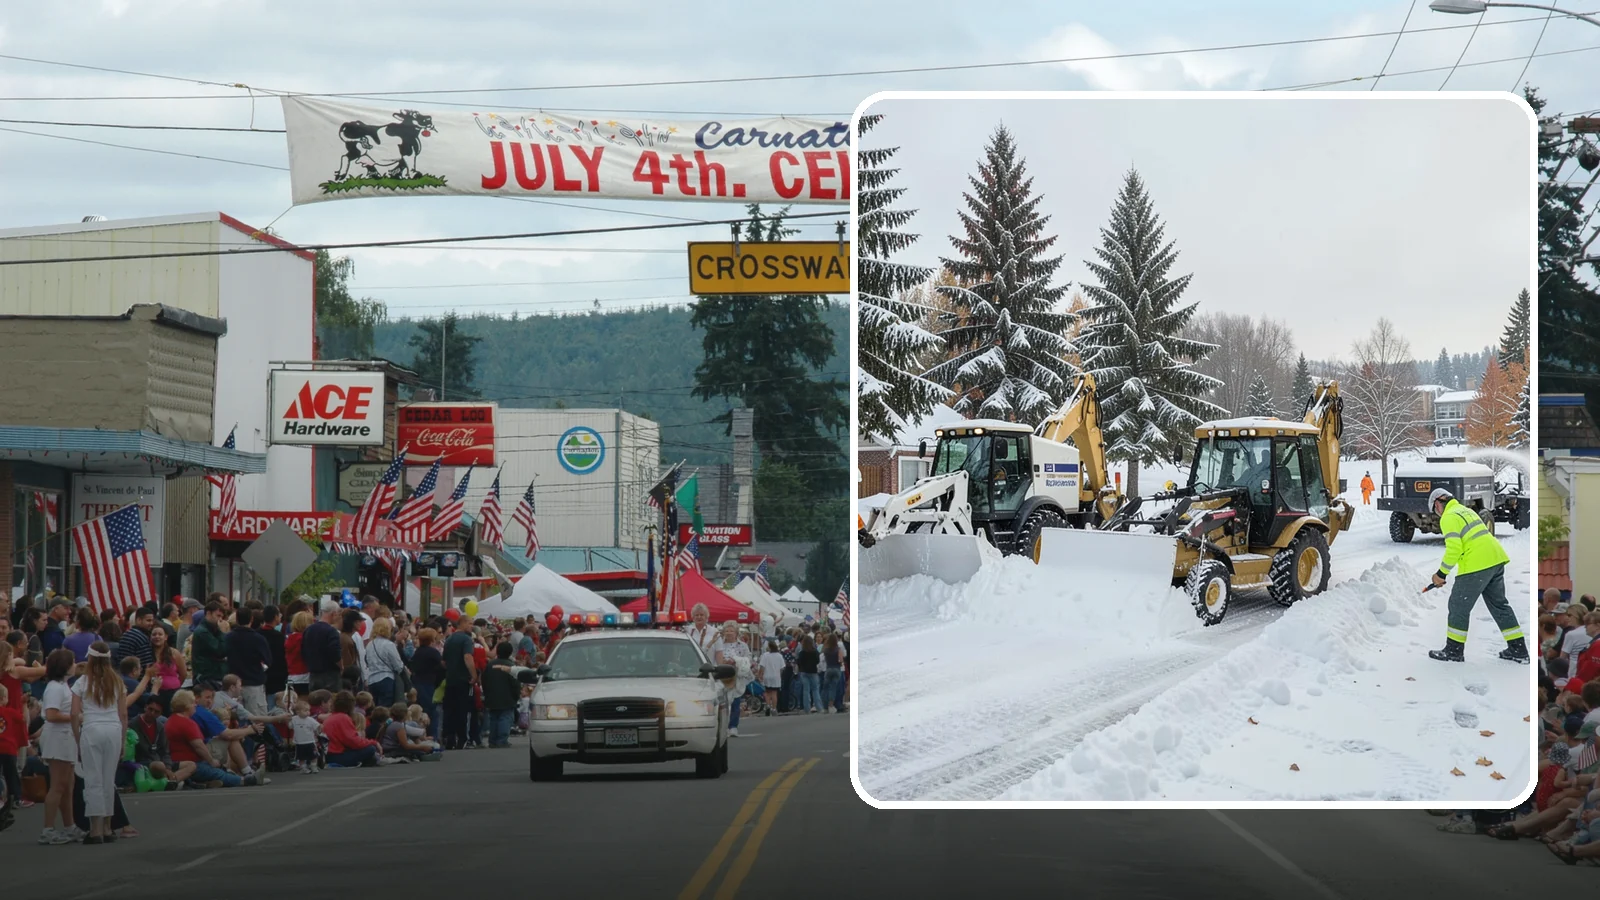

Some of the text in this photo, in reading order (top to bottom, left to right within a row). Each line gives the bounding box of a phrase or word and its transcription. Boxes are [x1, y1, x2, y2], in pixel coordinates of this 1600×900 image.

[695, 121, 850, 150] Carnat
[482, 141, 605, 192] JULY
[632, 150, 746, 198] 4th.
[697, 254, 850, 280] CROSSWA
[282, 380, 373, 420] ACE
[405, 409, 452, 422] CEDAR
[284, 421, 370, 436] Hardware
[416, 428, 477, 447] Coca-Cola
[354, 467, 384, 480] Simpl
[96, 485, 124, 495] Vincent
[126, 486, 136, 495] de
[138, 486, 155, 495] Paul
[688, 526, 741, 535] CRNATION
[699, 535, 730, 543] GLASS
